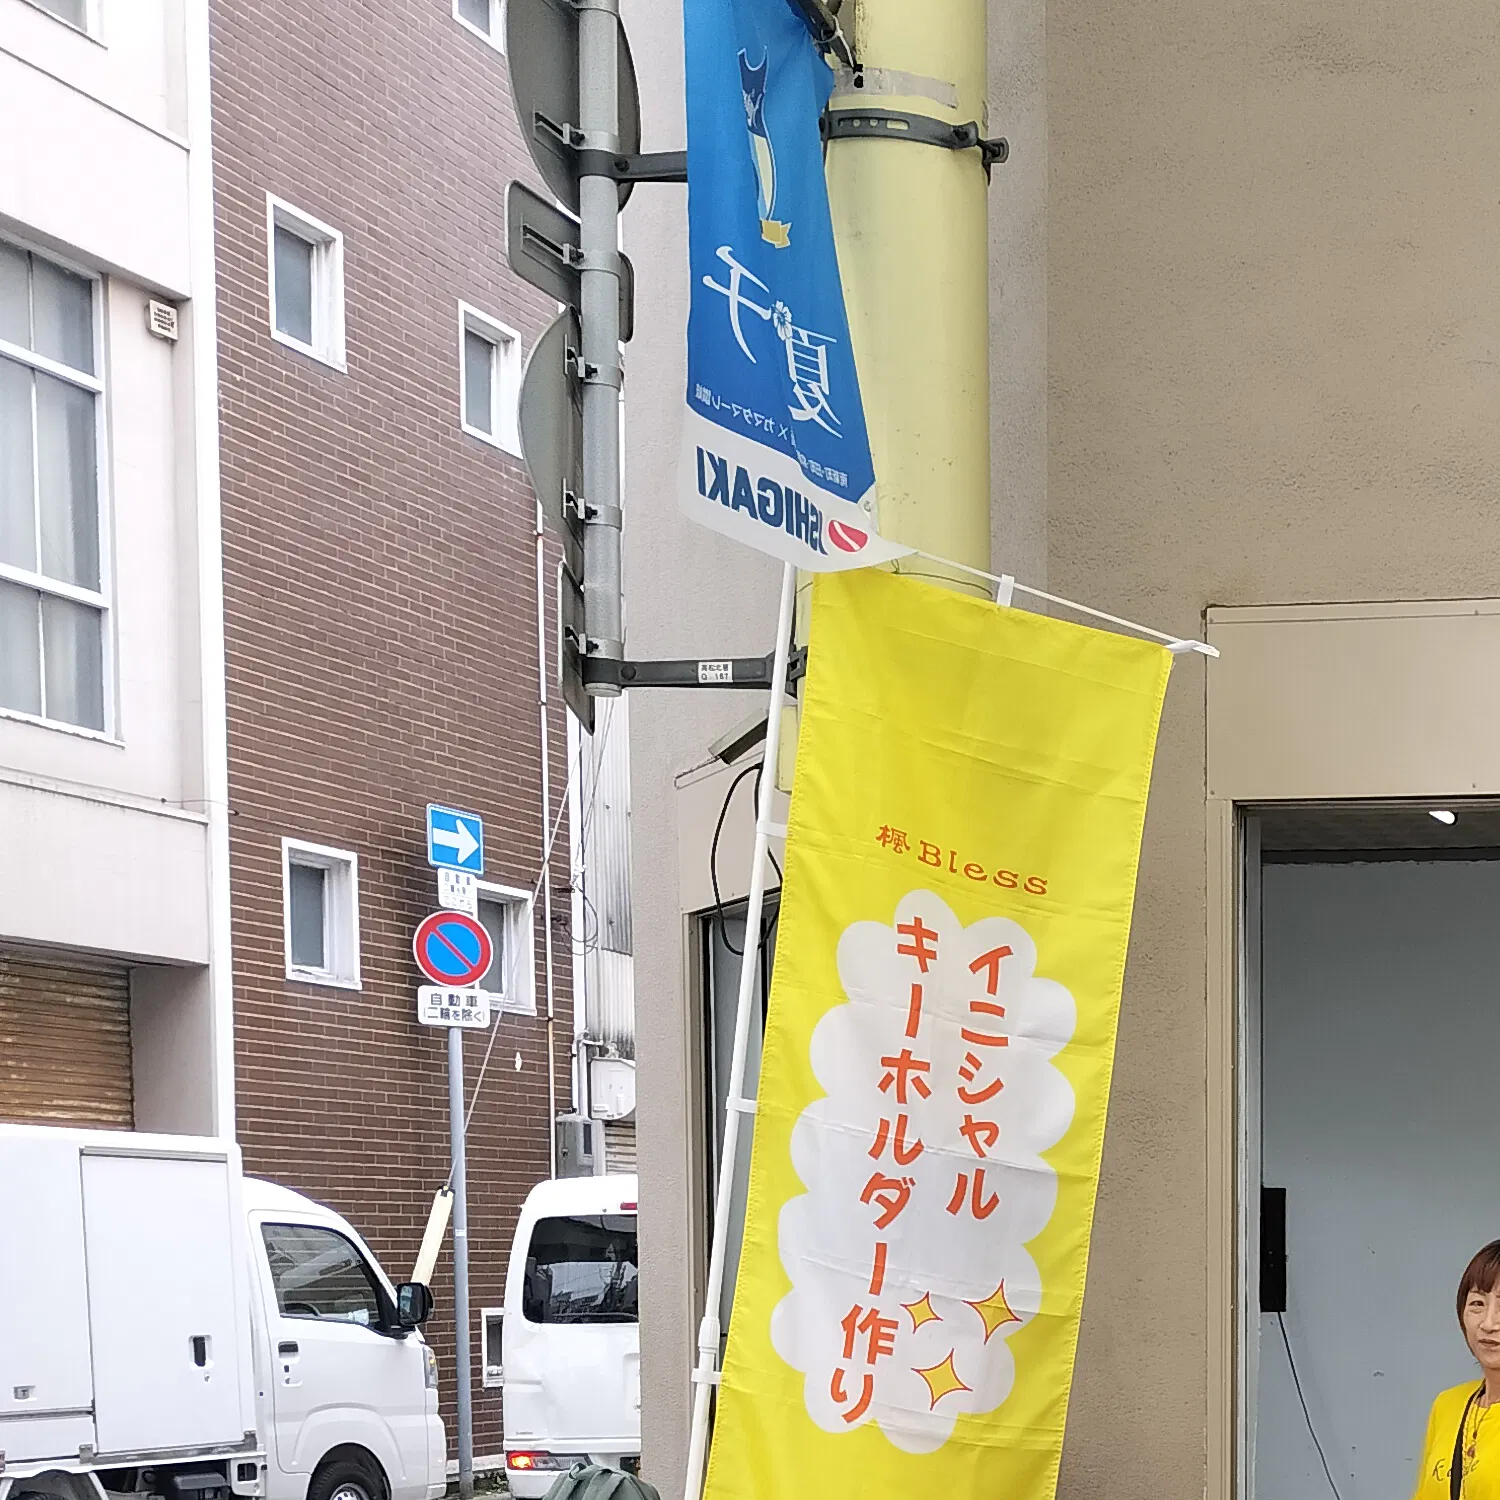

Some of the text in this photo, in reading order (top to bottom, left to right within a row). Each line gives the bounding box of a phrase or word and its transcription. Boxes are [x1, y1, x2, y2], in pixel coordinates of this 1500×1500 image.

[430, 993, 478, 1007] 自動車
[946, 944, 1015, 1221] イニシャル
[830, 915, 939, 1425] キーホルダー作り
